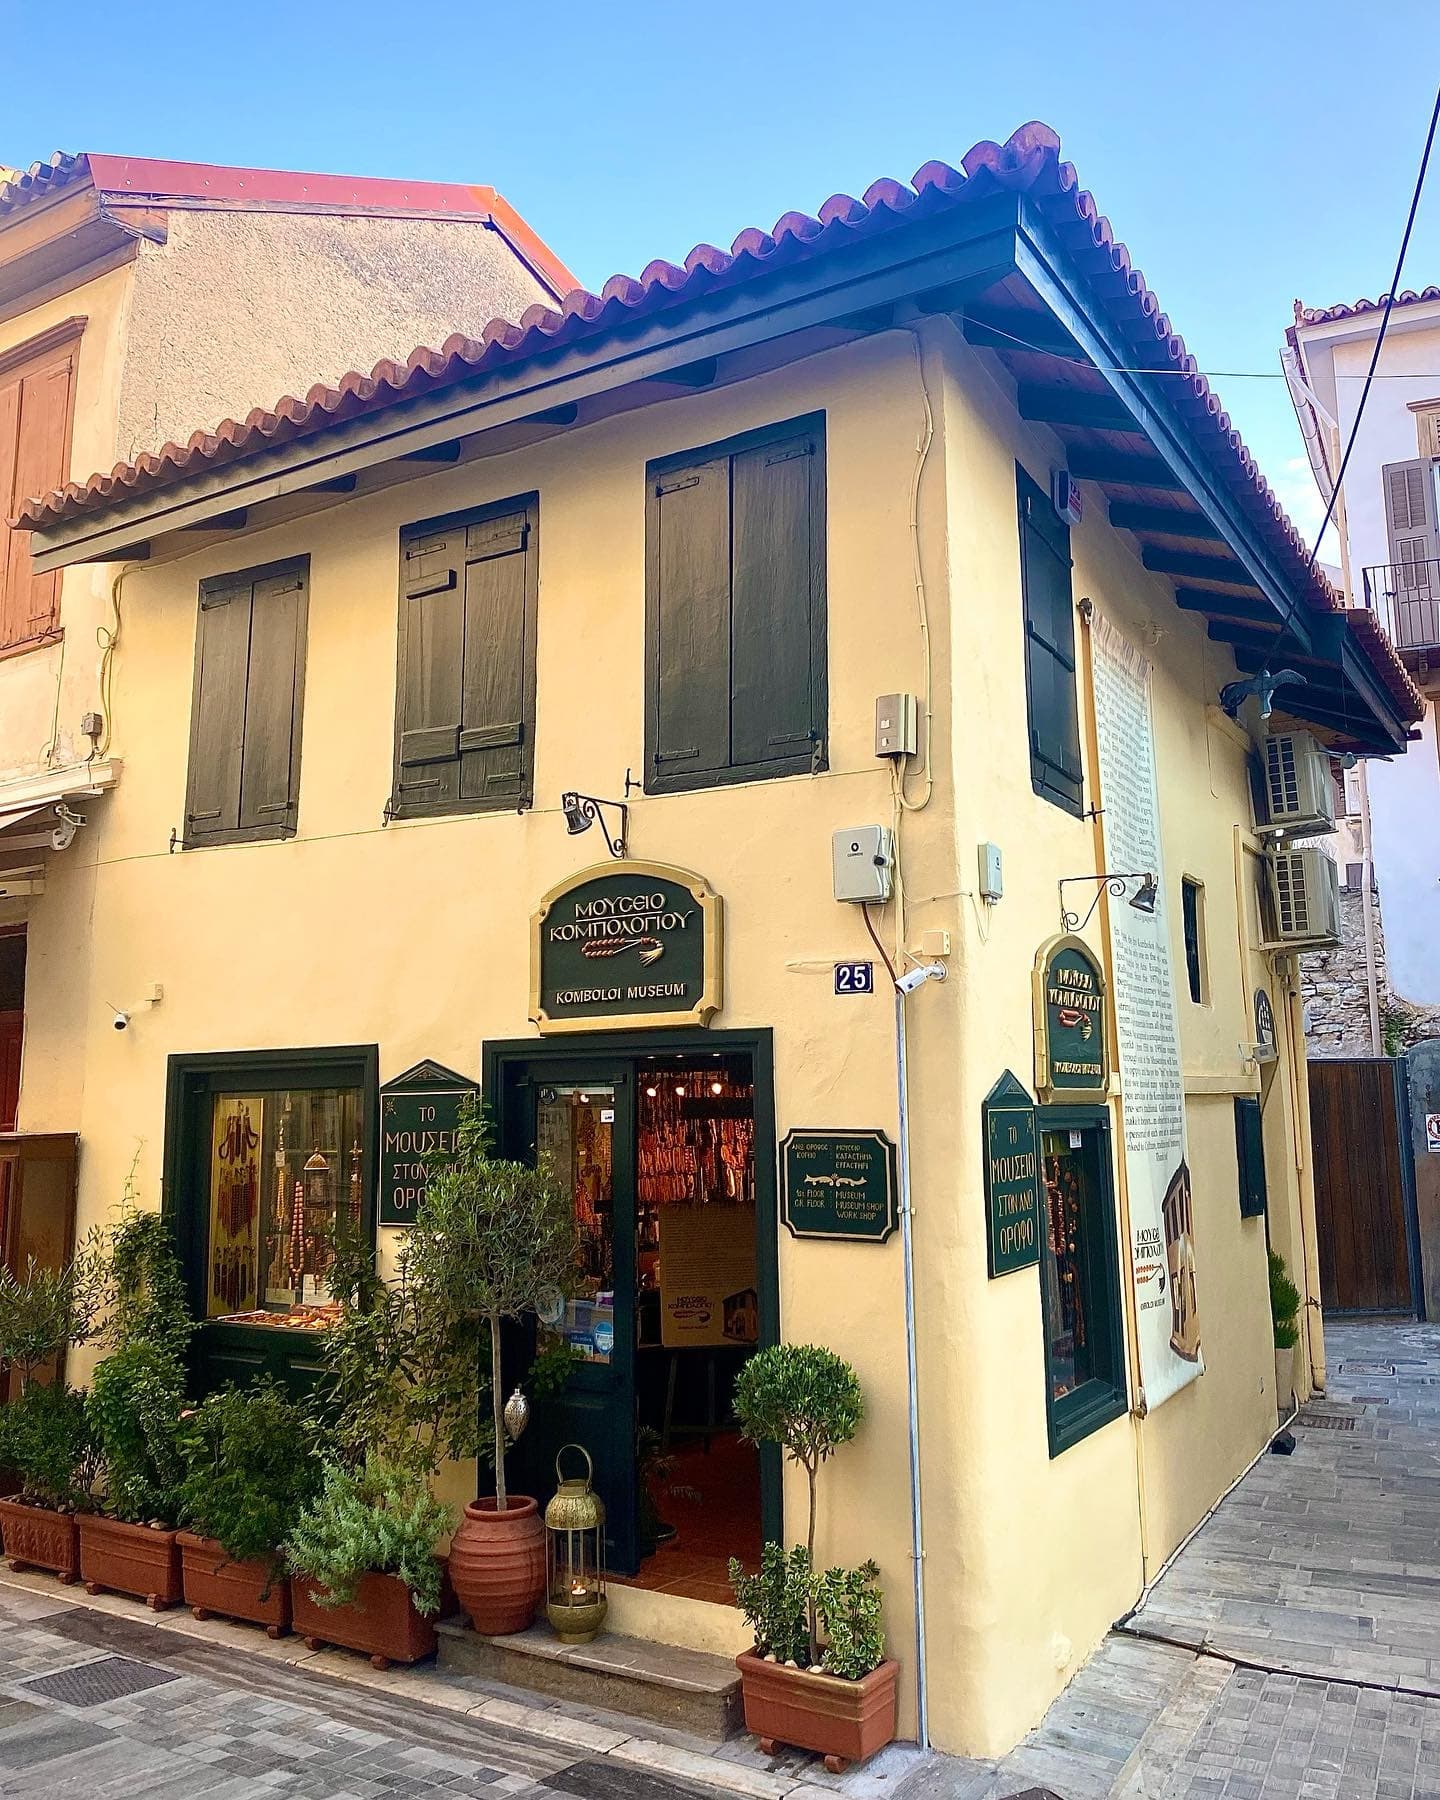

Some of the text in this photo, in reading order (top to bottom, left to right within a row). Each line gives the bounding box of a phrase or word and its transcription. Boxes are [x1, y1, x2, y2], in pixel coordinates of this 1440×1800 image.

[839, 966, 866, 990] 25
[556, 983, 685, 1004] KOMBOLOI MUSEUM
[418, 1106, 436, 1122] ΤΟ
[1007, 1126, 1017, 1144] ΤΟ
[393, 1164, 429, 1180] ΣΤΟΝ
[836, 1191, 865, 1199] MUSEUM
[836, 1201, 865, 1210] MUSEUM
[867, 1203, 885, 1212] SHOP
